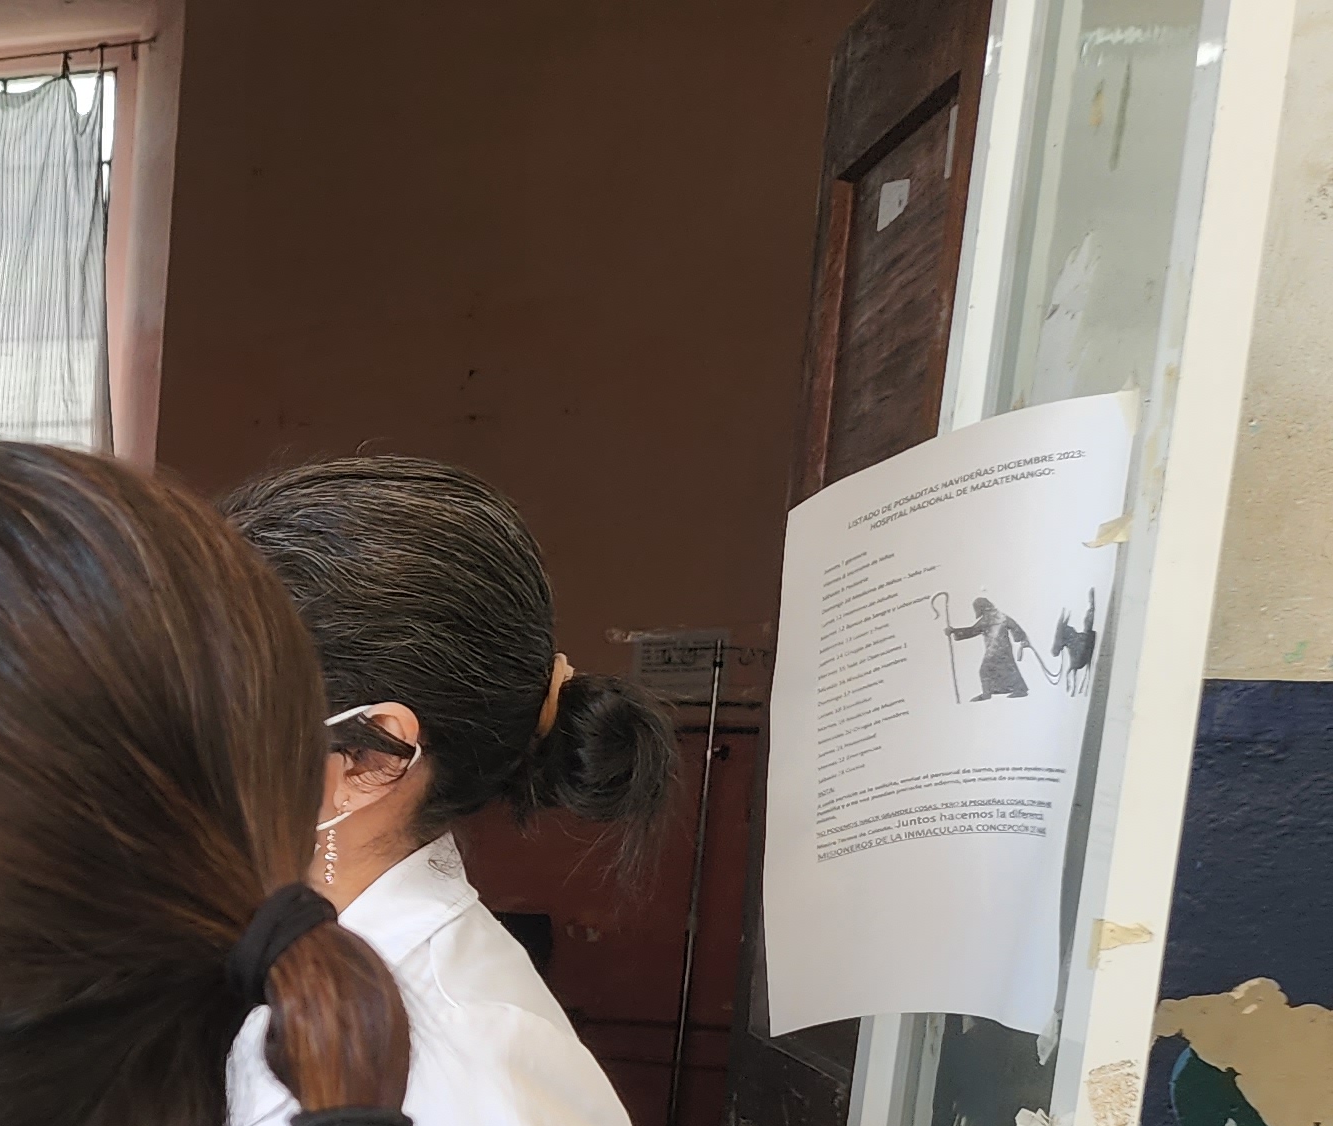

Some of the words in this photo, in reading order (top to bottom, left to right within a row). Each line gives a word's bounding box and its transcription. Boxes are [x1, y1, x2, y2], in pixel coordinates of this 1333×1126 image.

[847, 508, 880, 530] LISTADO
[881, 503, 892, 515] DE
[893, 483, 939, 508] POSADITAS
[941, 466, 995, 490] NAVIDEÑAS
[997, 453, 1055, 473] DICIEMBRE
[870, 508, 908, 531] HOSPITAL
[909, 491, 955, 513] NACIONAL
[956, 486, 968, 497] DE
[875, 835, 889, 845] DE
[891, 832, 902, 843] LA
[904, 824, 973, 840] INMACULADA
[895, 815, 937, 829] Juntos
[940, 810, 993, 821] hacemos
[996, 808, 1007, 819] la
